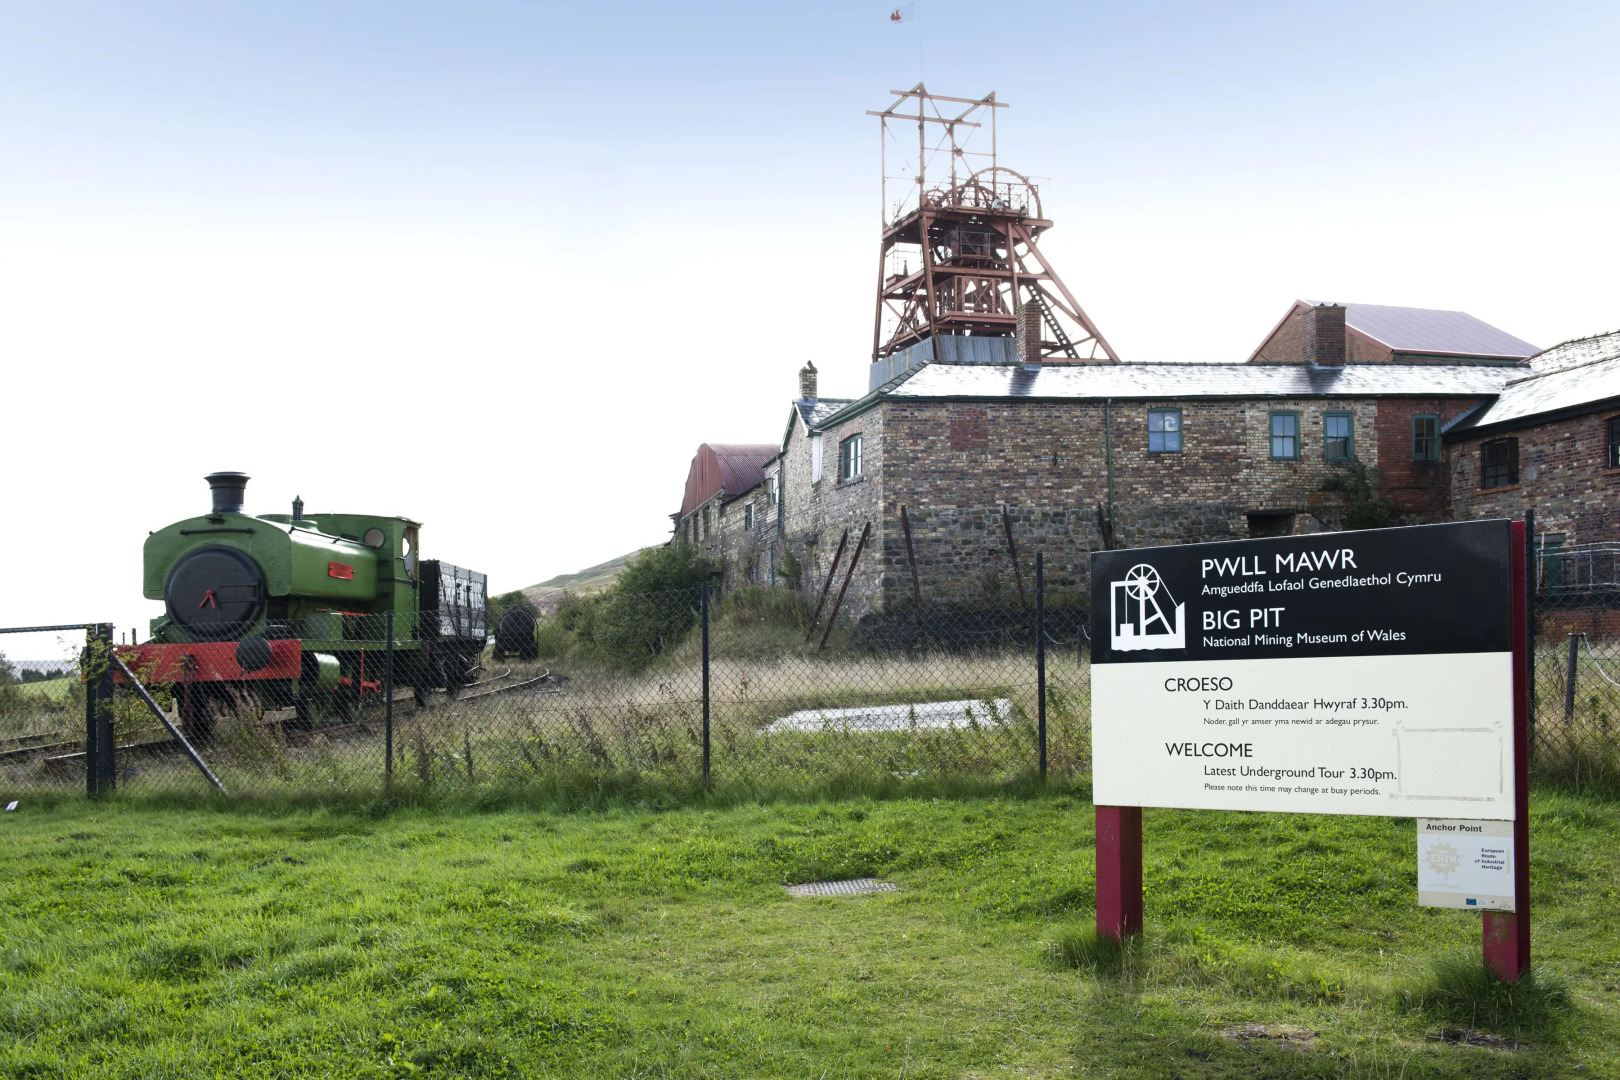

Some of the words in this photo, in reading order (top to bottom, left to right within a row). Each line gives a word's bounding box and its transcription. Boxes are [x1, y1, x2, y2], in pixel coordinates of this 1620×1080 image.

[1202, 556, 1266, 579] PWLL
[1276, 549, 1357, 574] MAWR
[1202, 581, 1264, 598] Amgueddfa
[1269, 579, 1303, 592] Lofaol
[1309, 573, 1391, 590] Genedlaethol
[1397, 572, 1441, 587] Cymru
[1203, 610, 1240, 631] BIG
[1251, 608, 1285, 629] PIT
[1203, 634, 1251, 648] National
[1254, 634, 1293, 648] Mining
[1297, 632, 1347, 644] Museum
[1352, 630, 1364, 643] of
[1367, 629, 1406, 642] Wales
[1164, 677, 1234, 692] CROESO
[1202, 700, 1212, 710] Y
[1215, 700, 1245, 710] Daith
[1248, 699, 1310, 710] Danddaear
[1313, 698, 1358, 713] Hwyraf
[1361, 698, 1409, 713] 3.30pm.
[1228, 717, 1240, 727] gall
[1241, 719, 1249, 727] yr
[1274, 719, 1290, 727] yma
[1291, 717, 1313, 725] newid
[1325, 717, 1351, 727] adegau
[1353, 719, 1379, 727] prysur.
[1164, 743, 1253, 758] WELCOME
[1204, 765, 1237, 777] Latest
[1240, 766, 1315, 781] Underground
[1317, 767, 1345, 779] Tour
[1349, 768, 1397, 783] 3.30pm.
[1204, 783, 1225, 791] Please
[1260, 785, 1276, 793] time
[1277, 786, 1293, 795] may
[1293, 785, 1319, 796] change
[1330, 786, 1348, 796] busy
[1350, 787, 1381, 797] periods.
[1426, 823, 1456, 832] Anchor
[1459, 824, 1483, 833] Point
